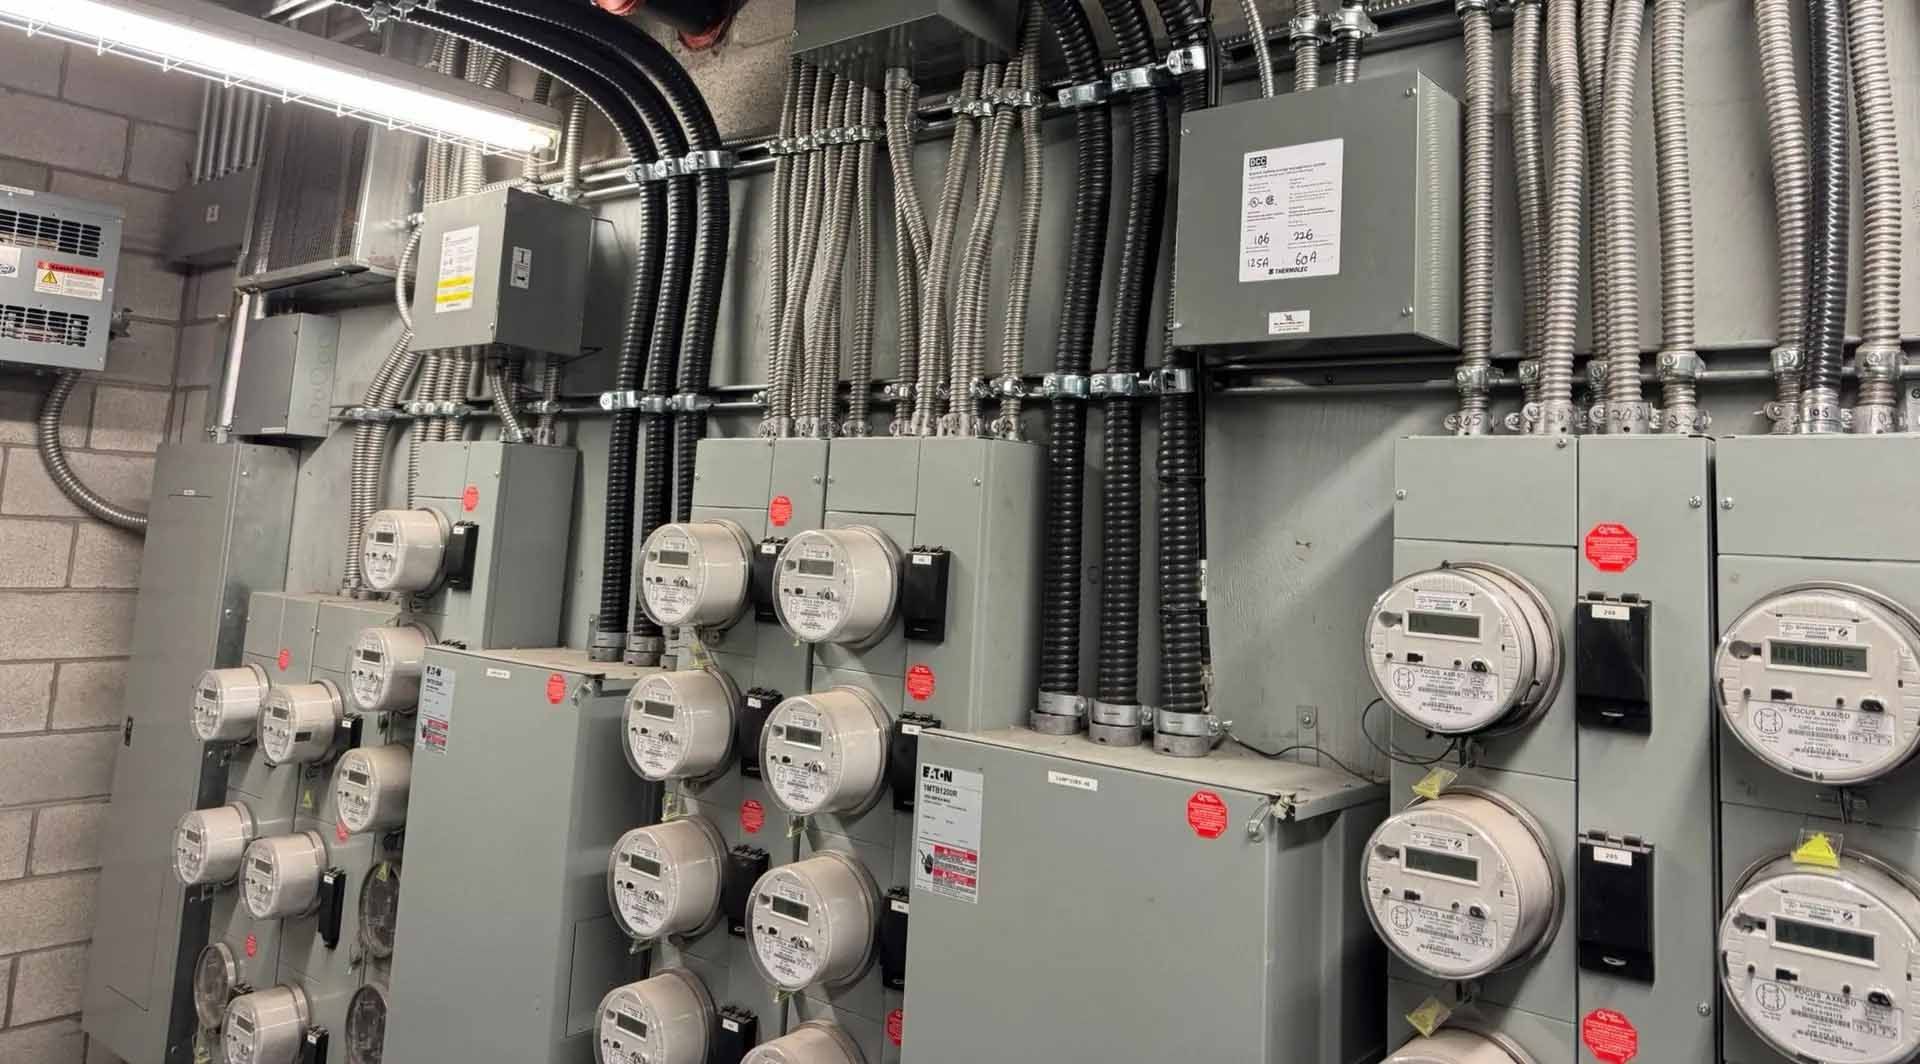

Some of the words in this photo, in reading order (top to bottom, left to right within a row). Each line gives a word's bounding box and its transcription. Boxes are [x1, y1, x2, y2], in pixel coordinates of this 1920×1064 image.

[1254, 232, 1270, 245] 106
[1293, 228, 1314, 240] 226
[1247, 257, 1269, 268] 125A
[1275, 266, 1309, 275] THERMOLEC
[1789, 707, 1816, 716] FOCUS
